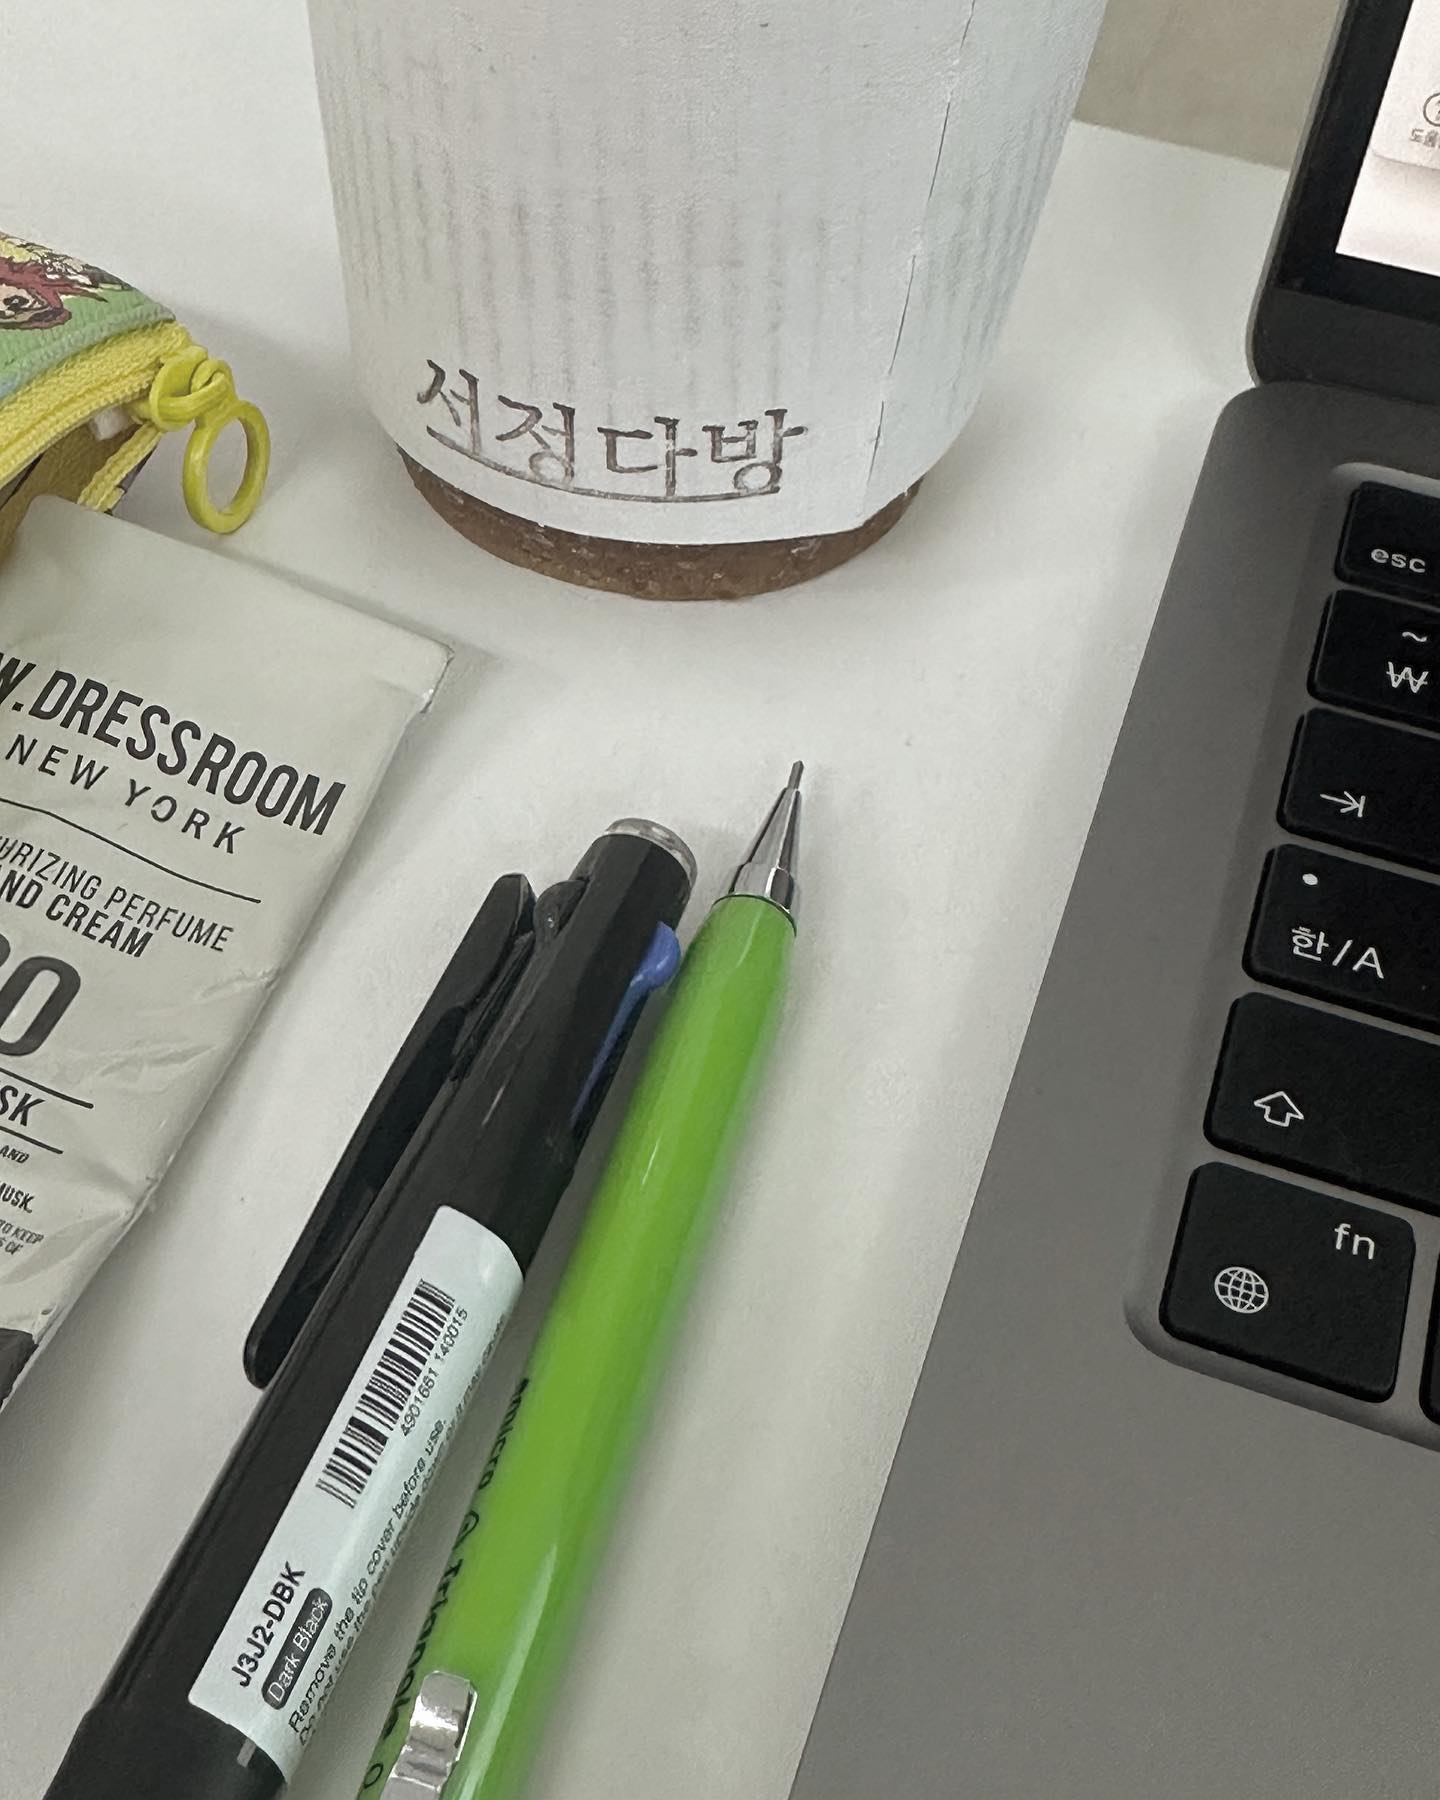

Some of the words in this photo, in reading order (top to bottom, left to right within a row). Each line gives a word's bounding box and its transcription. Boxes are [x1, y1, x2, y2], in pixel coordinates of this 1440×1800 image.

[1370, 548, 1427, 574] esc
[5, 733, 110, 791] NEW
[124, 778, 246, 854] YORK
[0, 865, 43, 909] ND
[46, 893, 153, 958] CREAM
[103, 886, 234, 952] PERFUME
[1291, 926, 1385, 979] 한/A
[0, 933, 81, 1057] 0
[1333, 1223, 1376, 1261] fn
[231, 1560, 306, 1688] J3J2-DBK
[288, 1643, 337, 1733] Remove
[334, 1607, 354, 1641] the
[367, 1518, 395, 1575] cover
[392, 1457, 426, 1519] before
[425, 1419, 447, 1456] use.
[268, 1653, 301, 1702] Dark
[293, 1596, 329, 1652] Black
